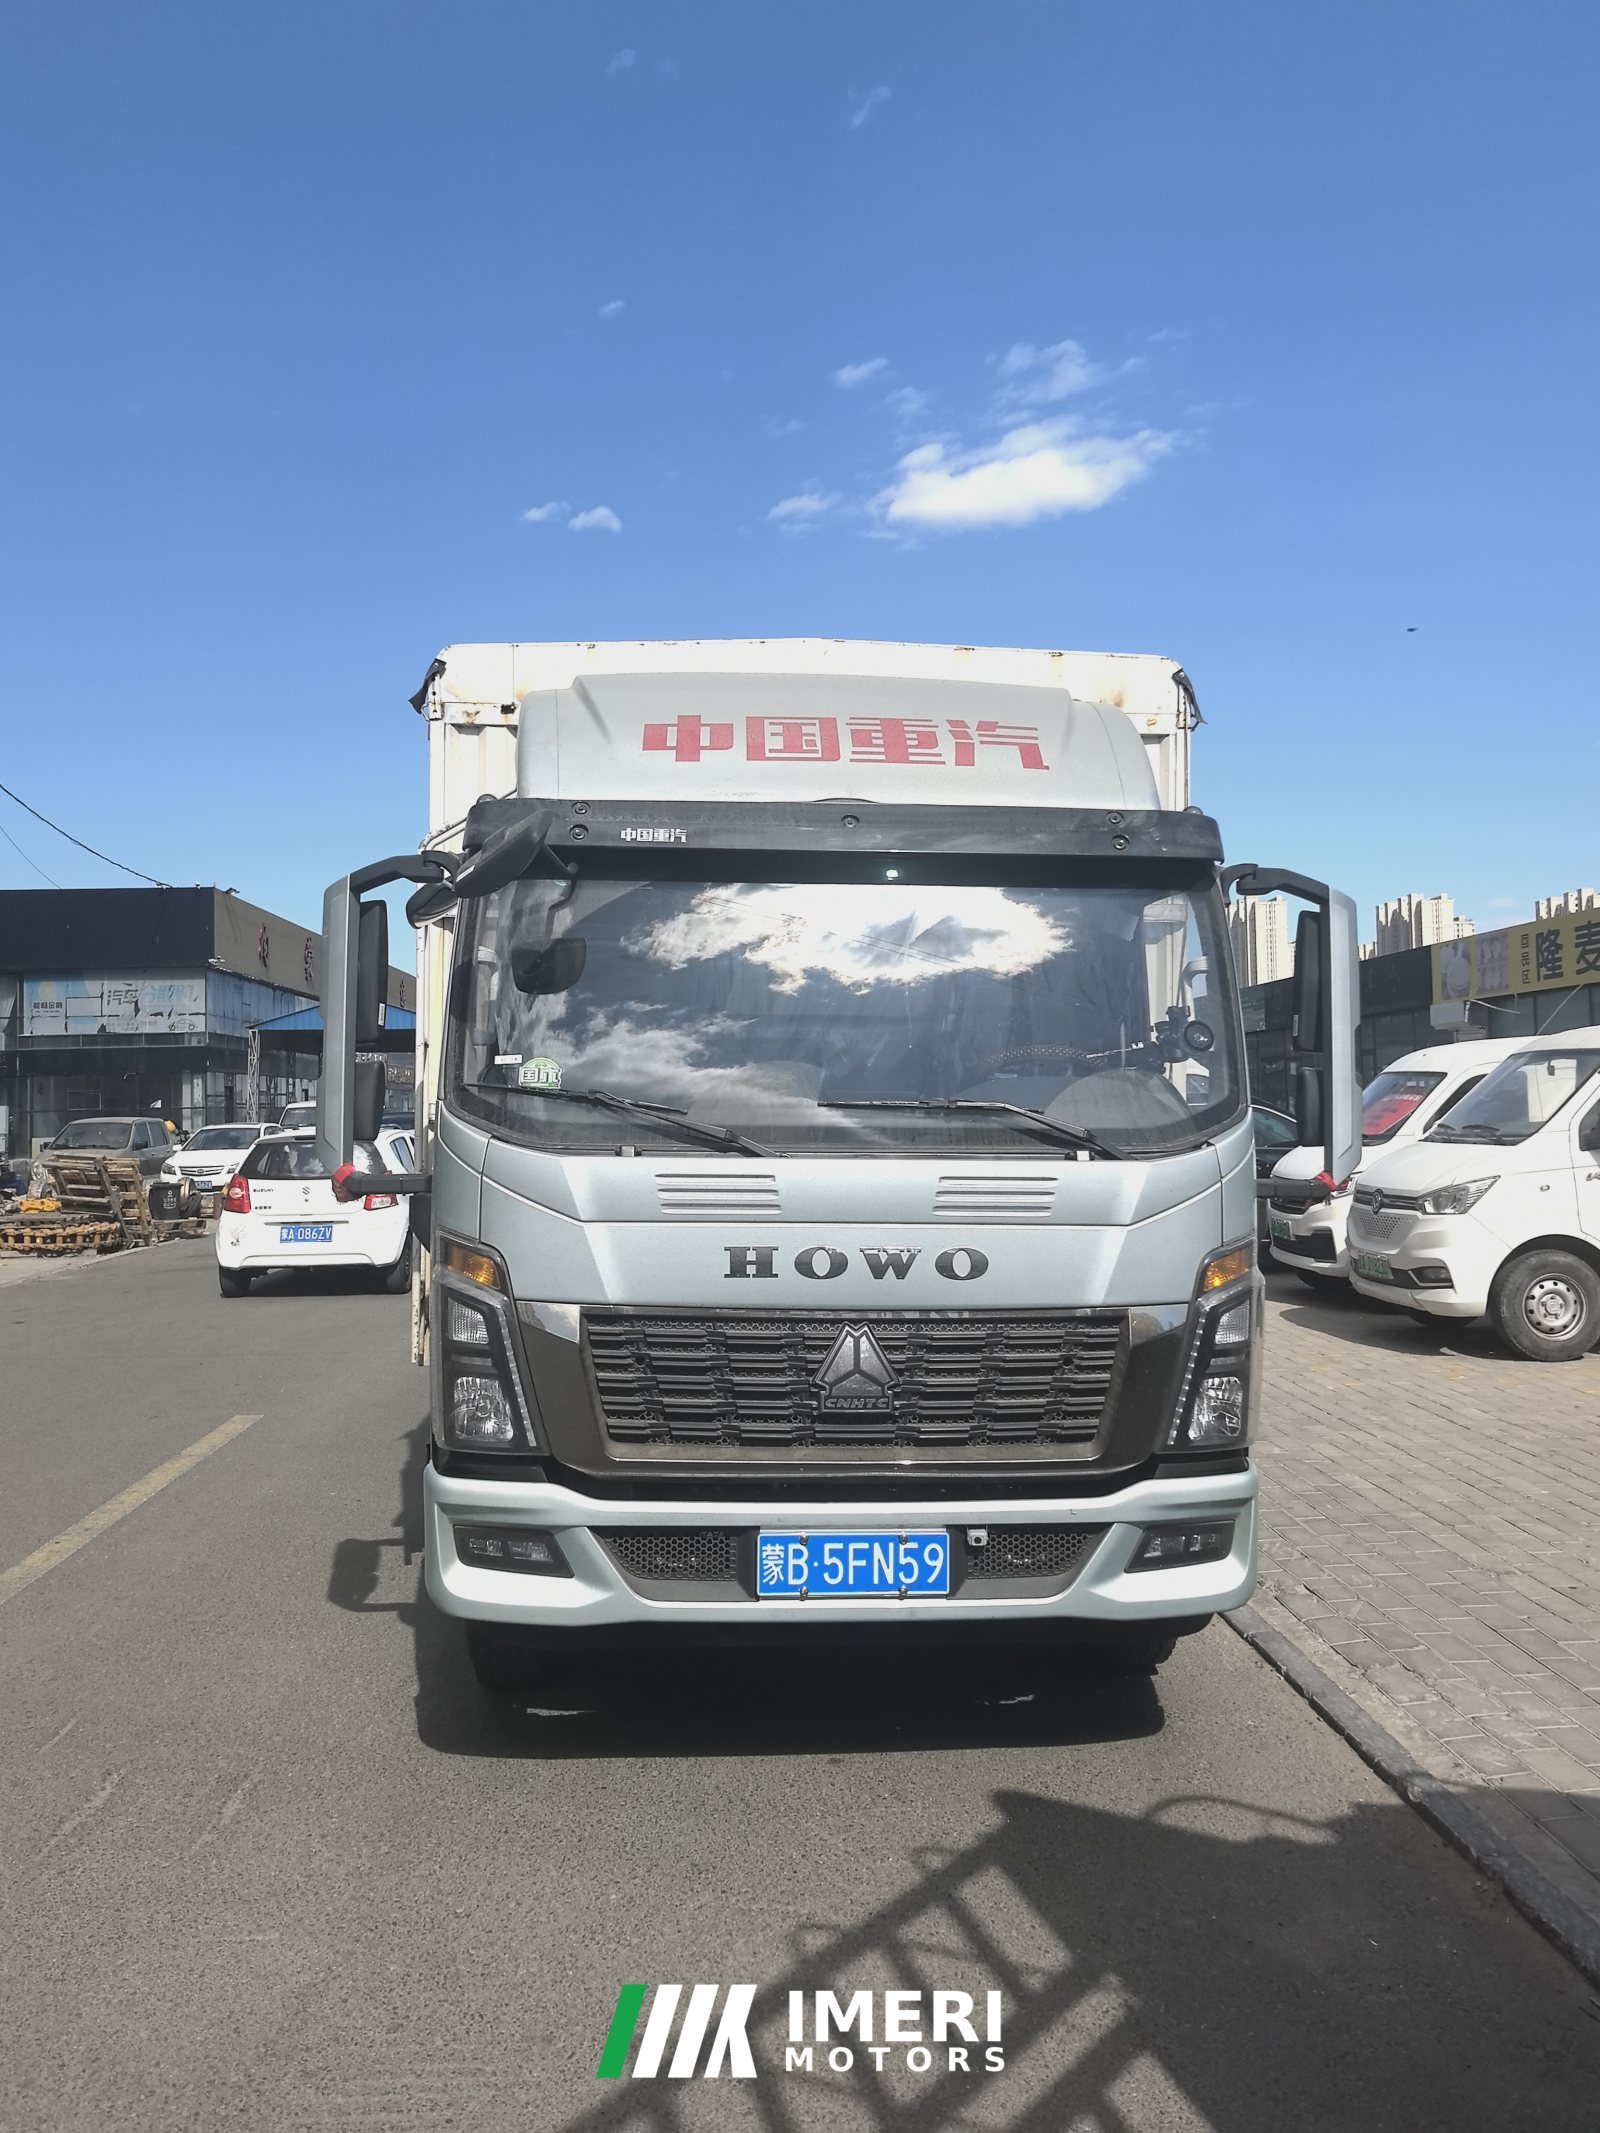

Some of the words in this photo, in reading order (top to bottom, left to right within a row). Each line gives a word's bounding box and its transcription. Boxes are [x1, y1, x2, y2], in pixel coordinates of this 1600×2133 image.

[642, 715, 1050, 771] 中国重汽
[620, 828, 687, 843] 中国重汽
[1535, 919, 1600, 983] 隆麦
[724, 1246, 989, 1280] HOWO
[825, 1398, 888, 1408] CNHTC
[762, 1542, 944, 1586] 蒙B·5FN59
